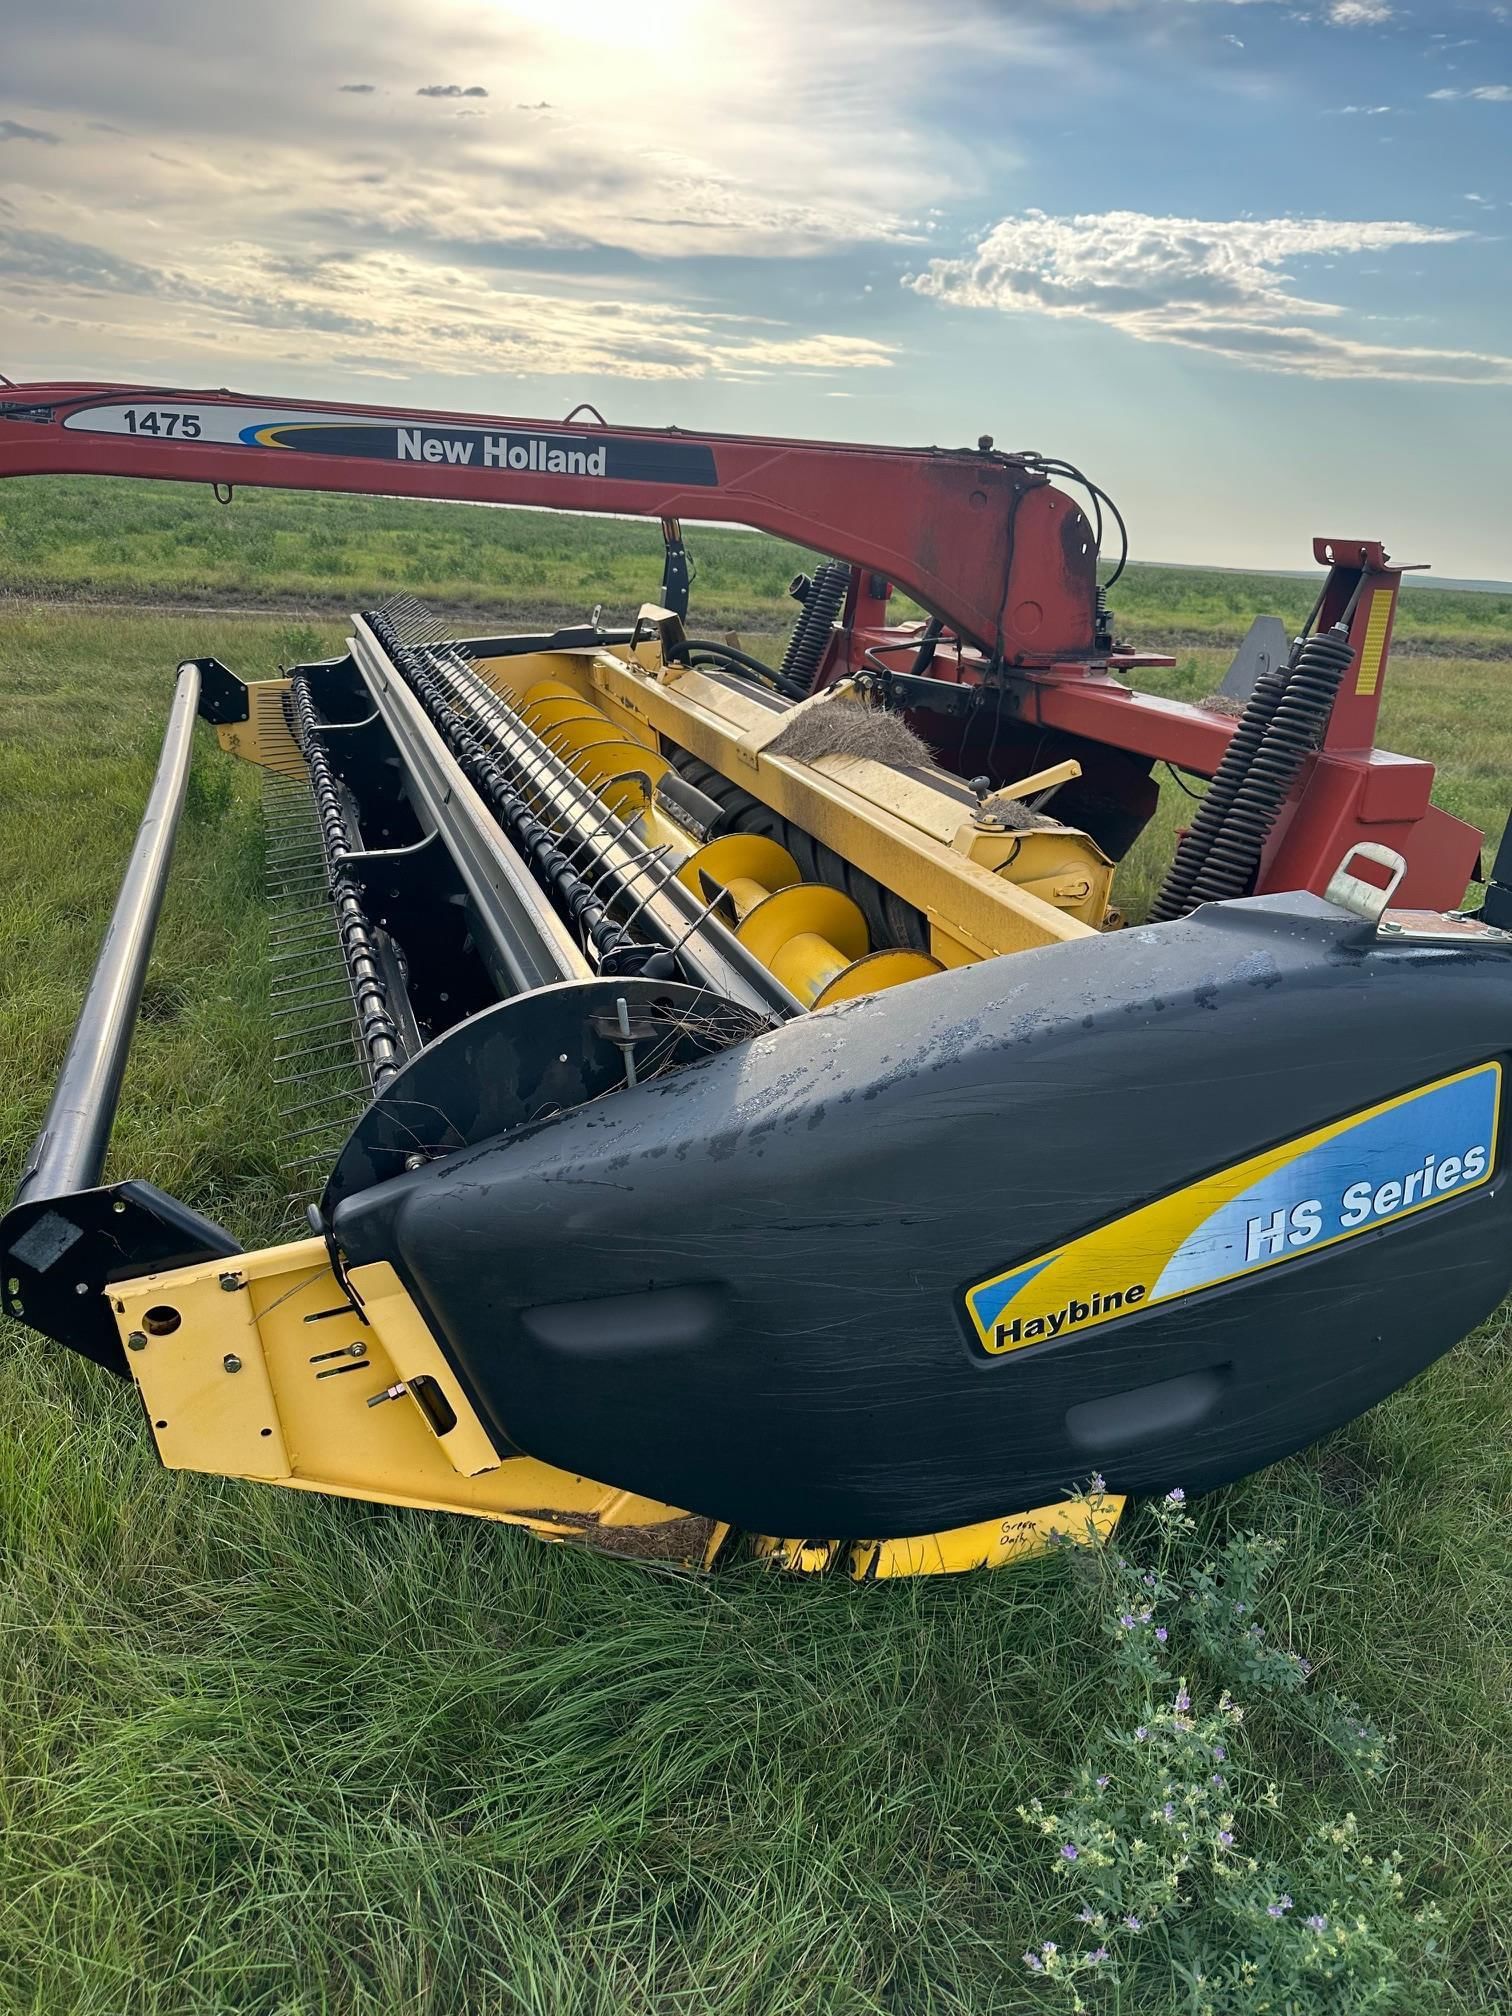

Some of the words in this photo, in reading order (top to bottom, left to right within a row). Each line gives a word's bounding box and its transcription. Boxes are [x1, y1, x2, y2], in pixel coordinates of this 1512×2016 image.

[123, 409, 202, 438] 1475
[397, 428, 474, 465] New
[483, 436, 606, 476] Holland
[1244, 1199, 1323, 1262] HS
[1339, 1144, 1487, 1227] Series
[994, 1283, 1147, 1348] Haybine
